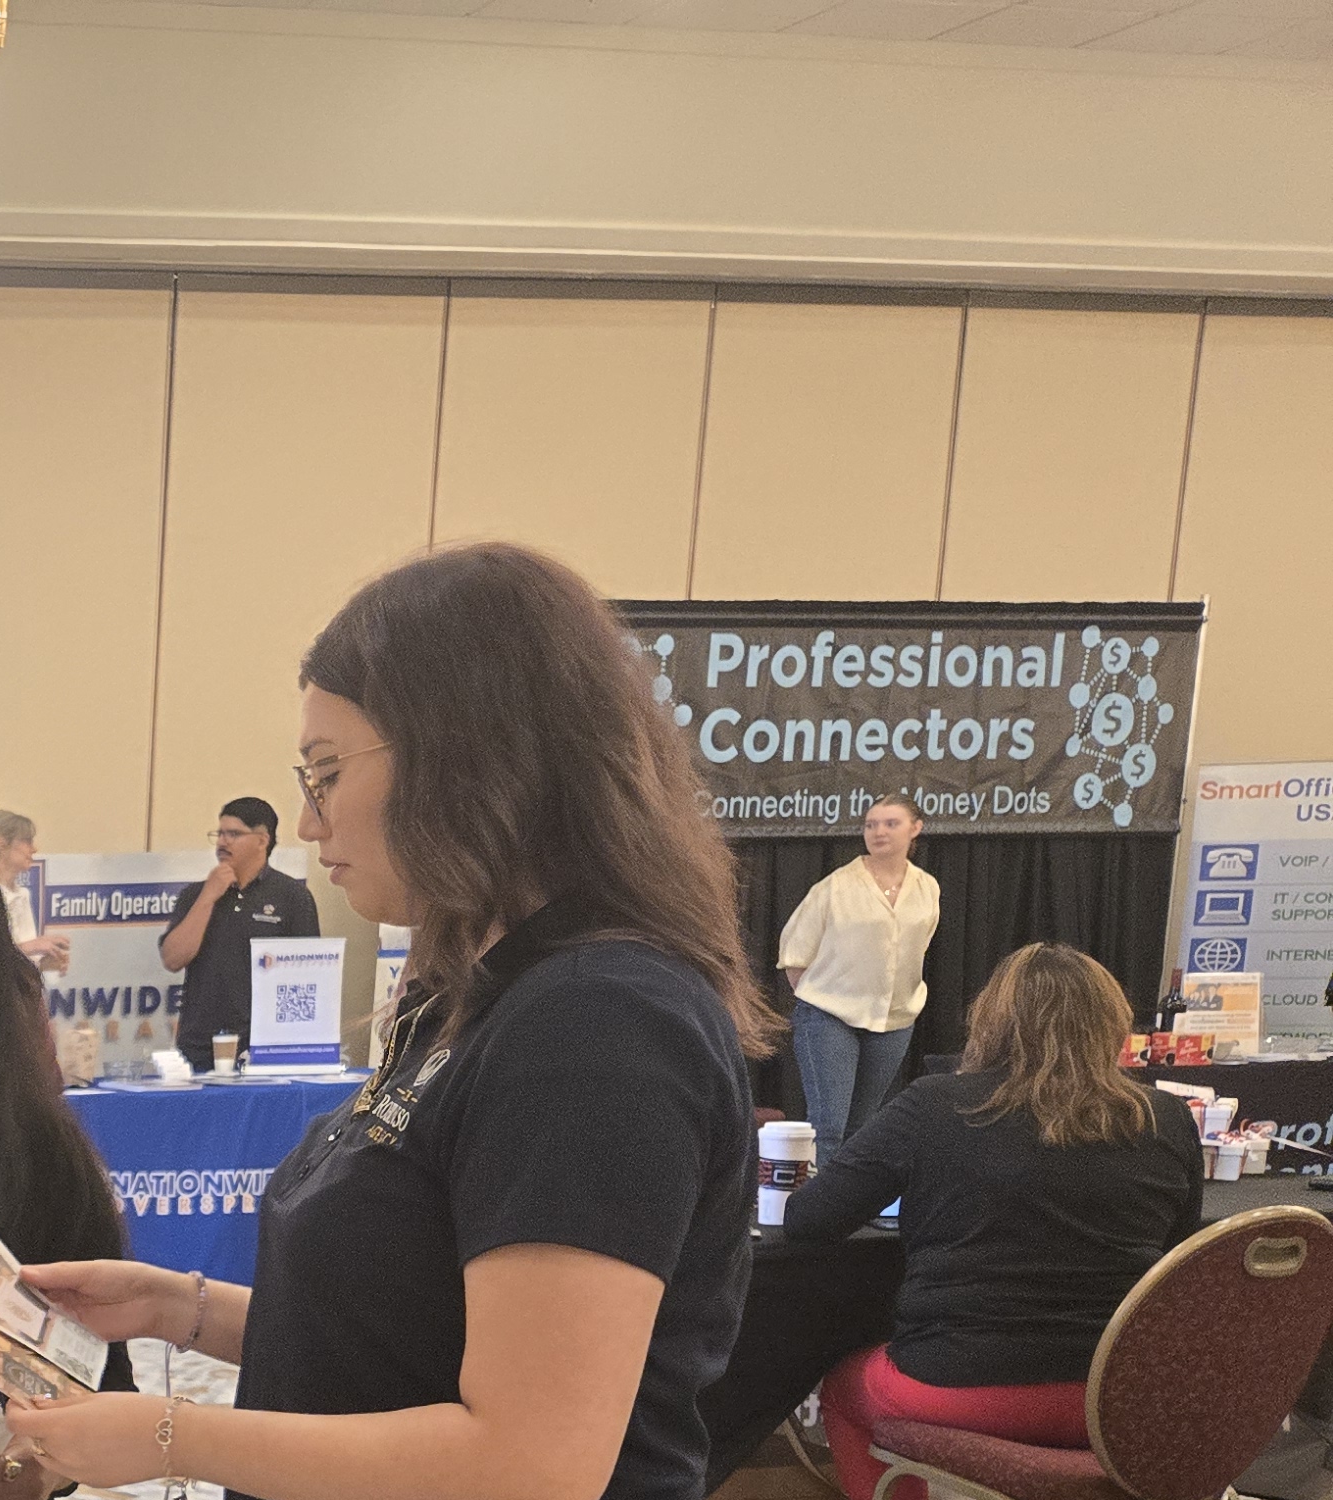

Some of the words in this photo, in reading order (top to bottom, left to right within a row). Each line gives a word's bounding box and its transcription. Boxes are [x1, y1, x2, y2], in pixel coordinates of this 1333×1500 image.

[706, 631, 1065, 689] Professional
[699, 707, 1035, 763] Connectors
[1200, 777, 1333, 800] SmartOffi
[849, 787, 885, 817] th
[993, 785, 1051, 814] Dots
[1296, 803, 1333, 822] US
[1279, 855, 1319, 867] VOIP
[51, 891, 107, 920] Family
[111, 890, 178, 919] Operate
[1273, 892, 1289, 904] IT
[276, 953, 340, 963] NATIONWIDE
[1262, 994, 1318, 1006] CLOUD
